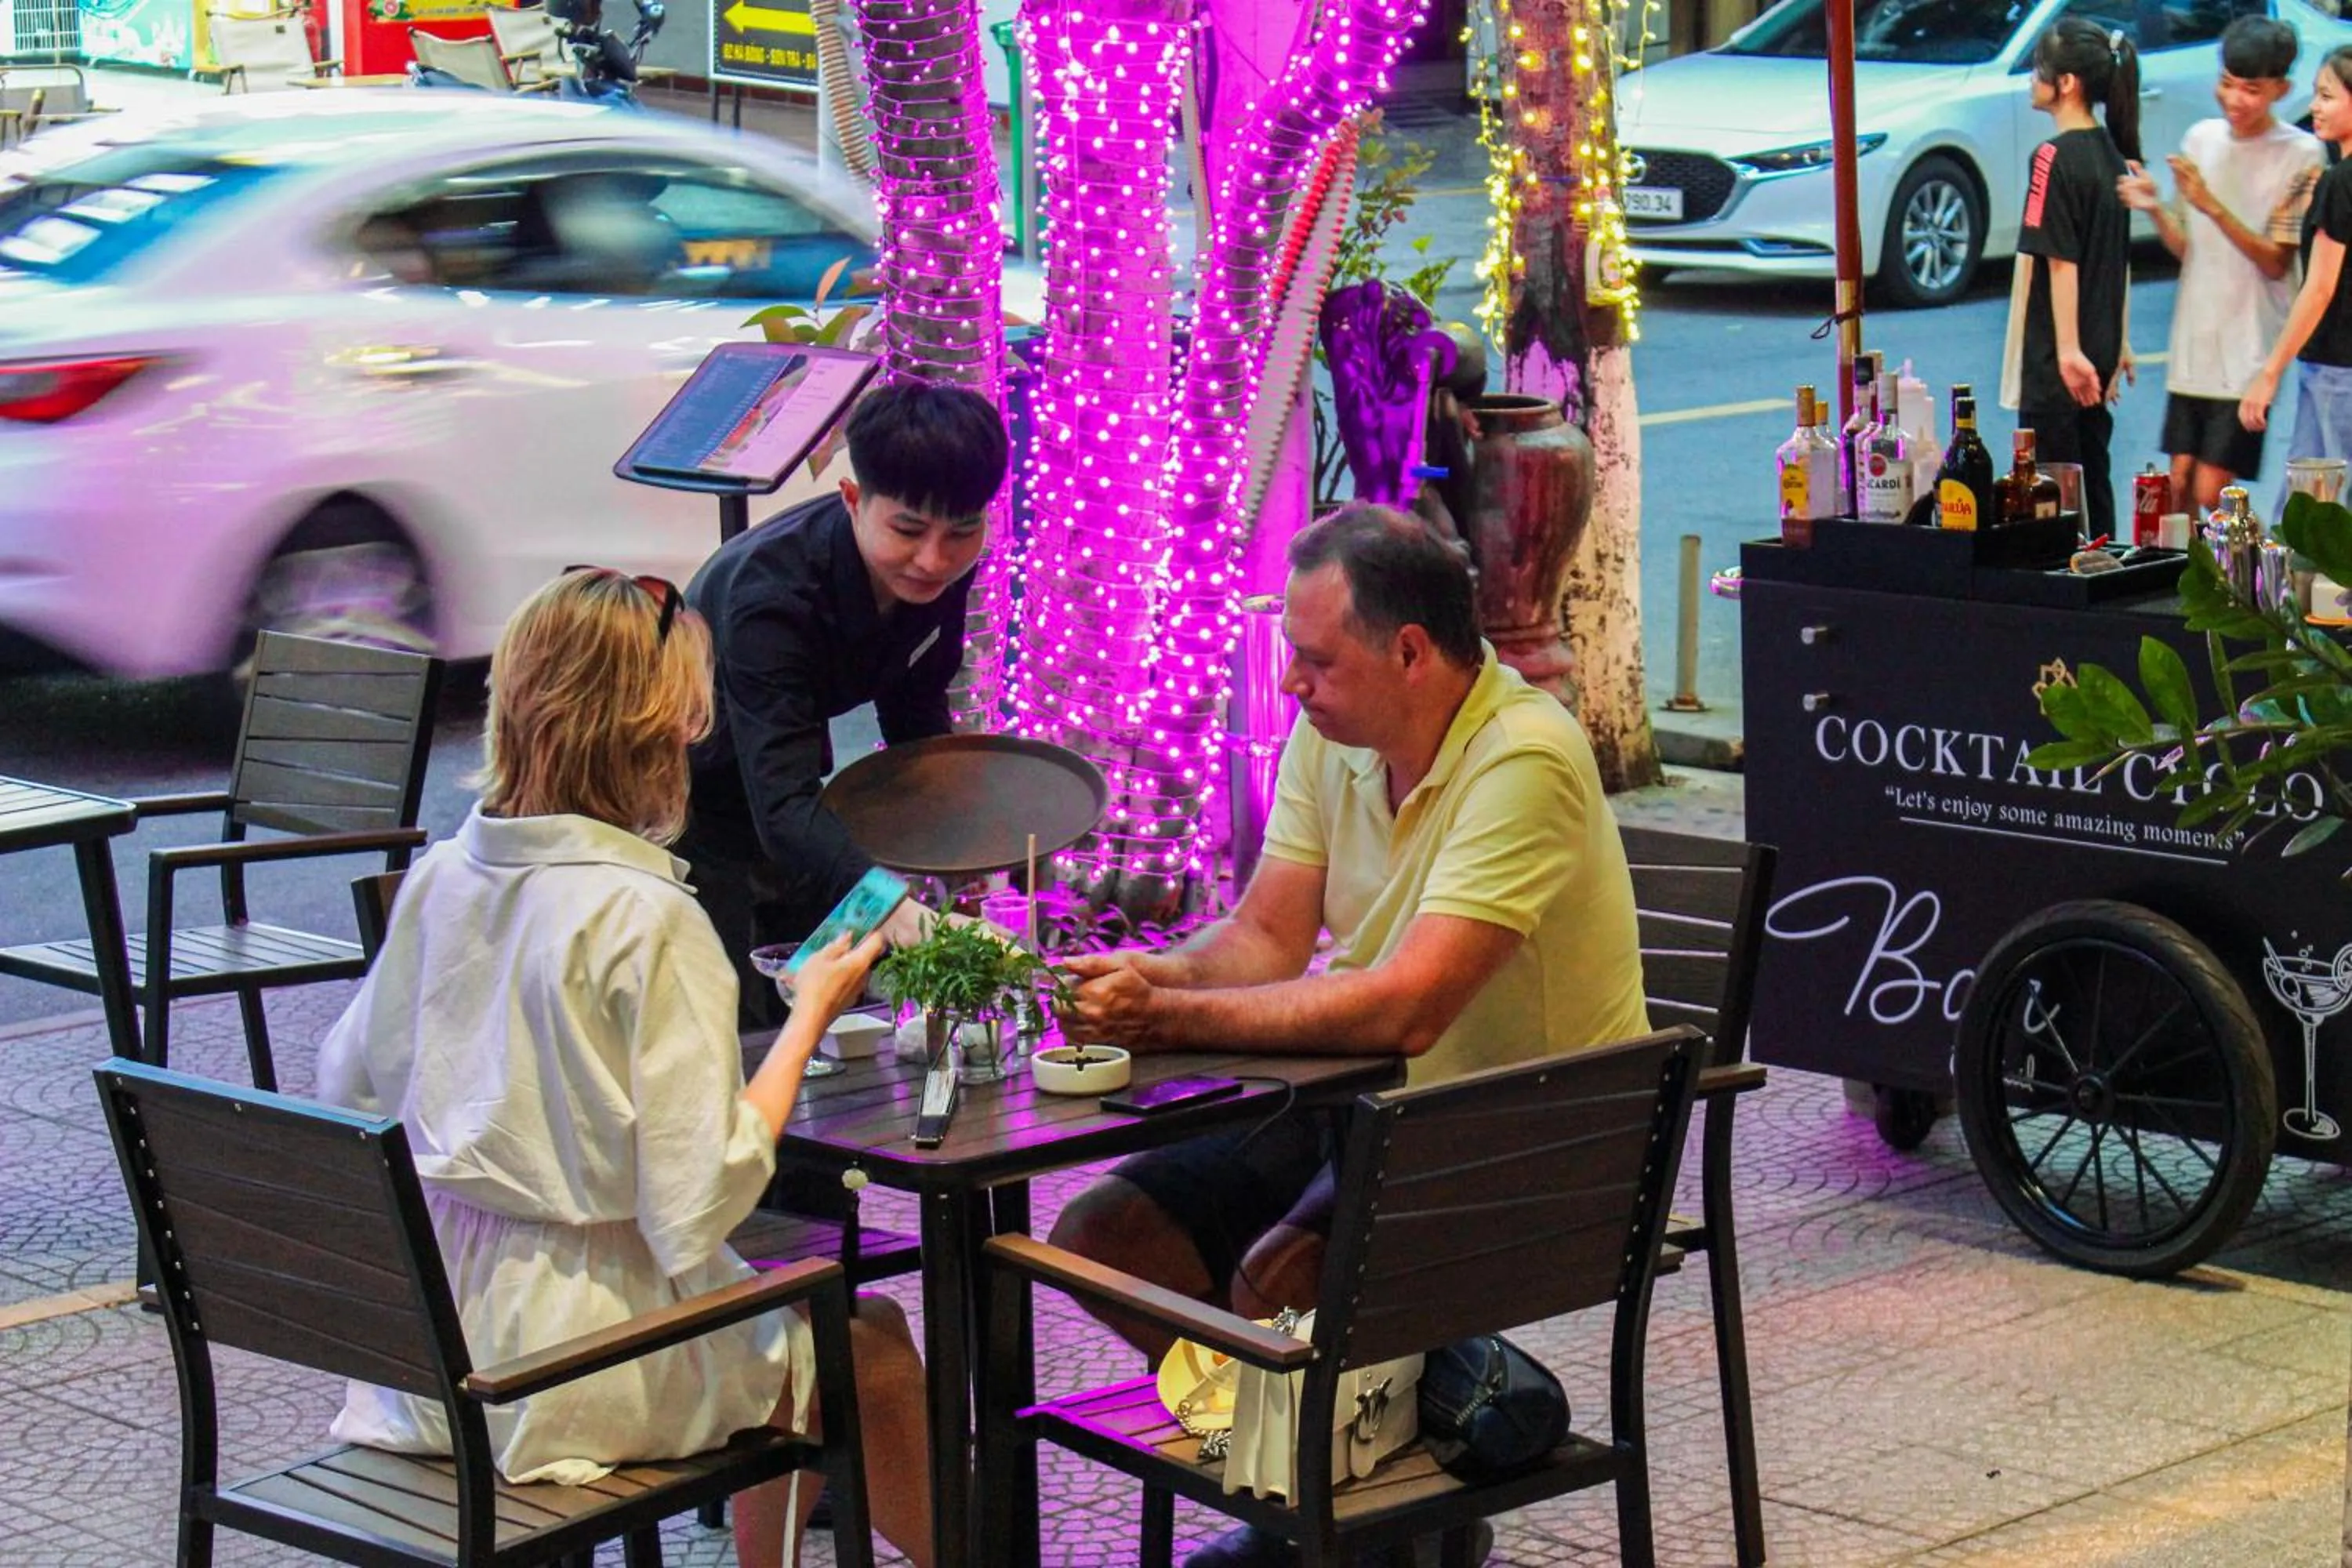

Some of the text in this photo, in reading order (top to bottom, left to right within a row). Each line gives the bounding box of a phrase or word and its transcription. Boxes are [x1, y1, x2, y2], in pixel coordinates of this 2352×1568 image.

[1942, 795, 1993, 822] enjoy
[1999, 805, 2048, 826] some
[2054, 812, 2137, 843] amazing
